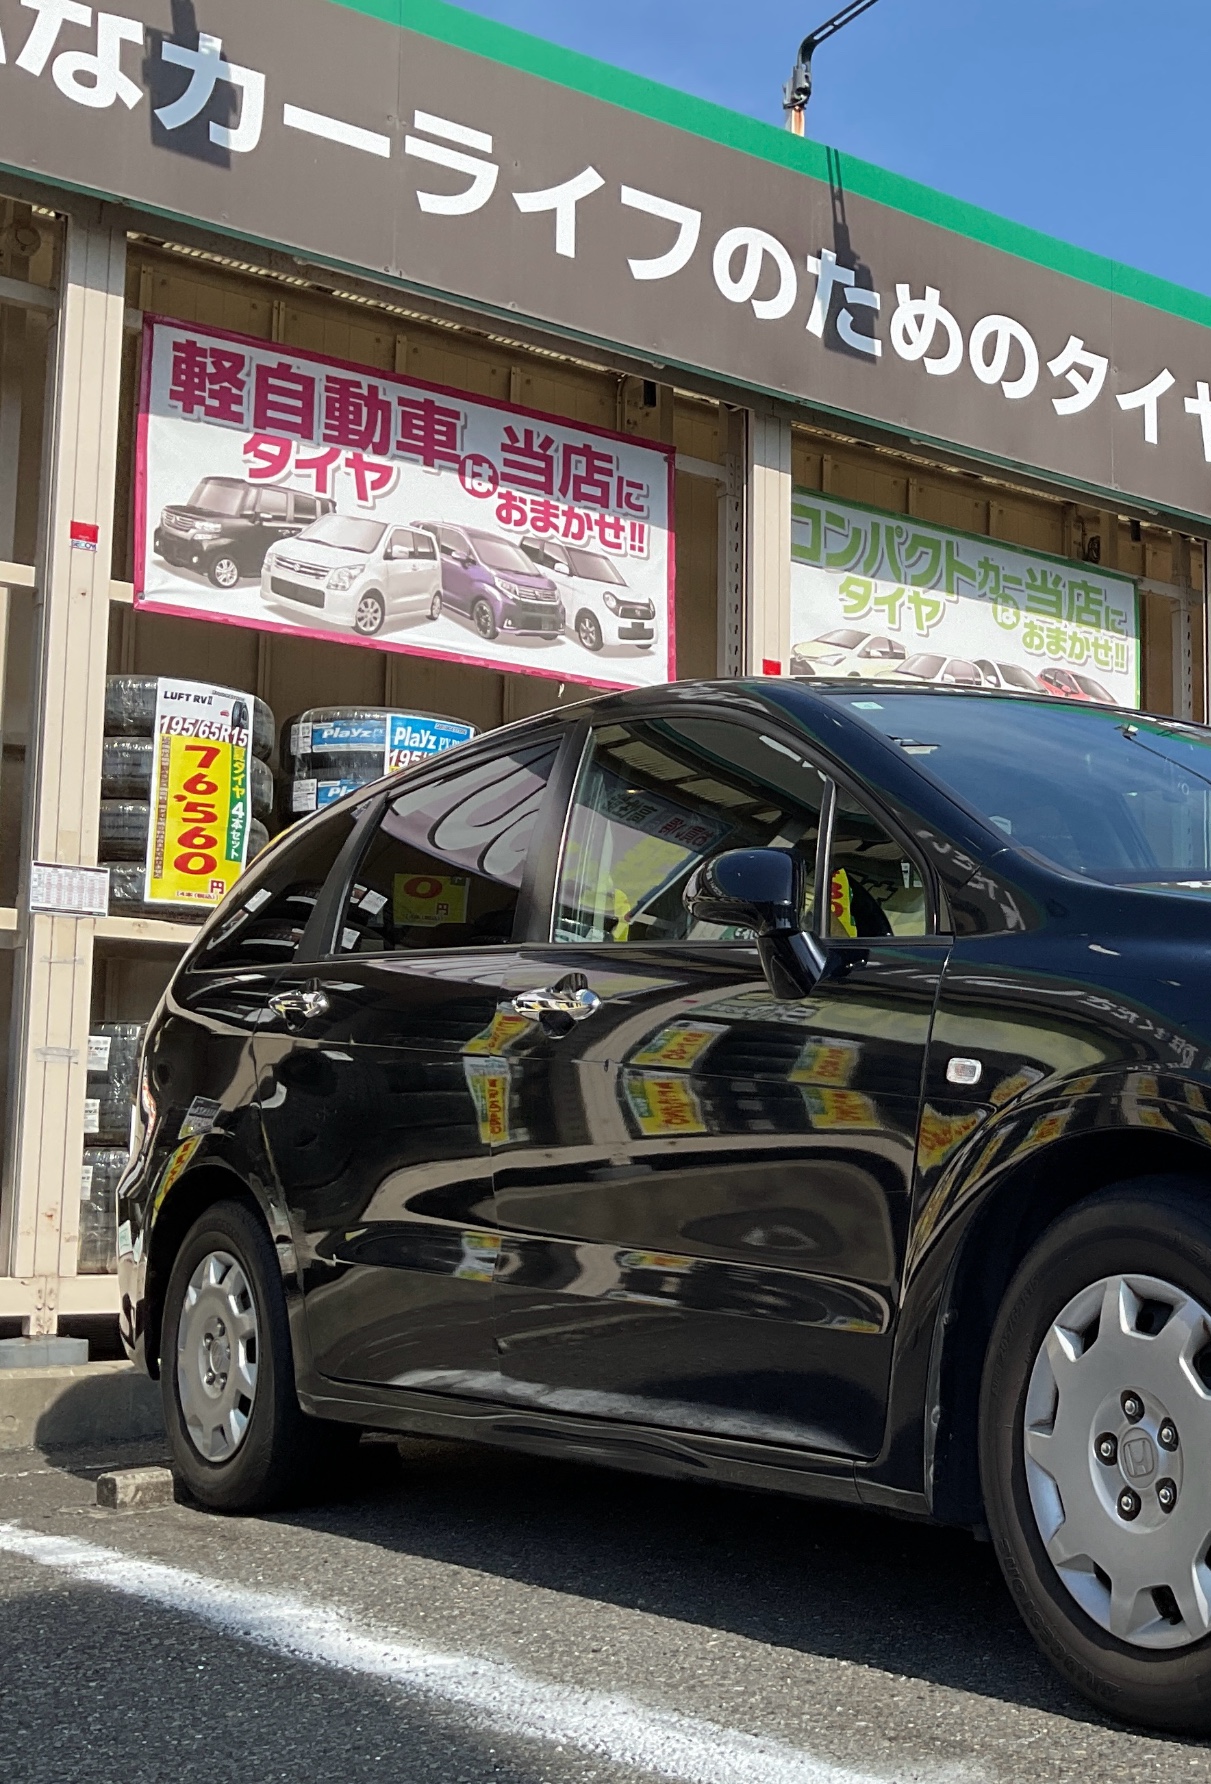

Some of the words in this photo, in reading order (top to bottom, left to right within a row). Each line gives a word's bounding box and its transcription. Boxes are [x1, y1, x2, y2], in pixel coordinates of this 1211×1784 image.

[243, 432, 393, 501] タイヤ
[839, 575, 941, 632] タイヤ
[164, 691, 191, 701] LUFT
[161, 716, 249, 747] 195/65R15
